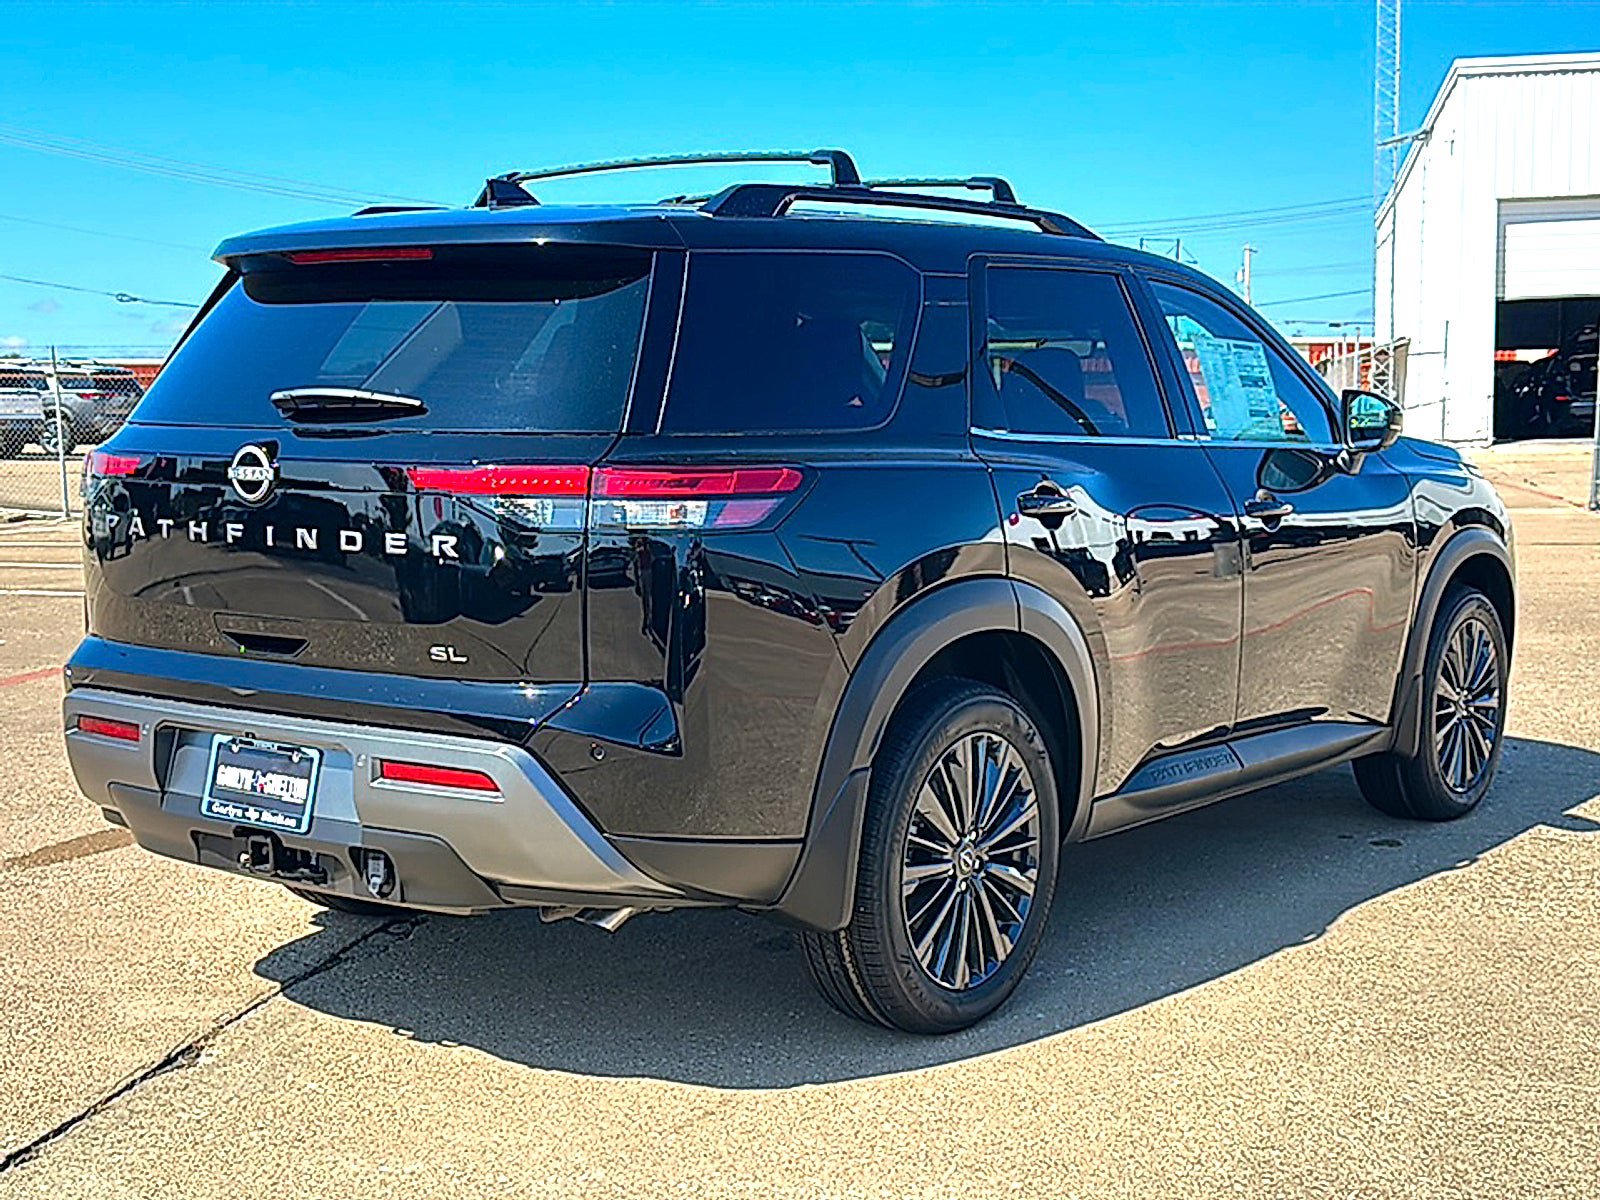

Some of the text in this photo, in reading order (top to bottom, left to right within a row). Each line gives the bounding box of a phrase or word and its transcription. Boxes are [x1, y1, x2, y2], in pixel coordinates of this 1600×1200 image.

[228, 466, 274, 481] NISSAN
[105, 510, 460, 557] PATHFINDER
[430, 646, 468, 664] SL
